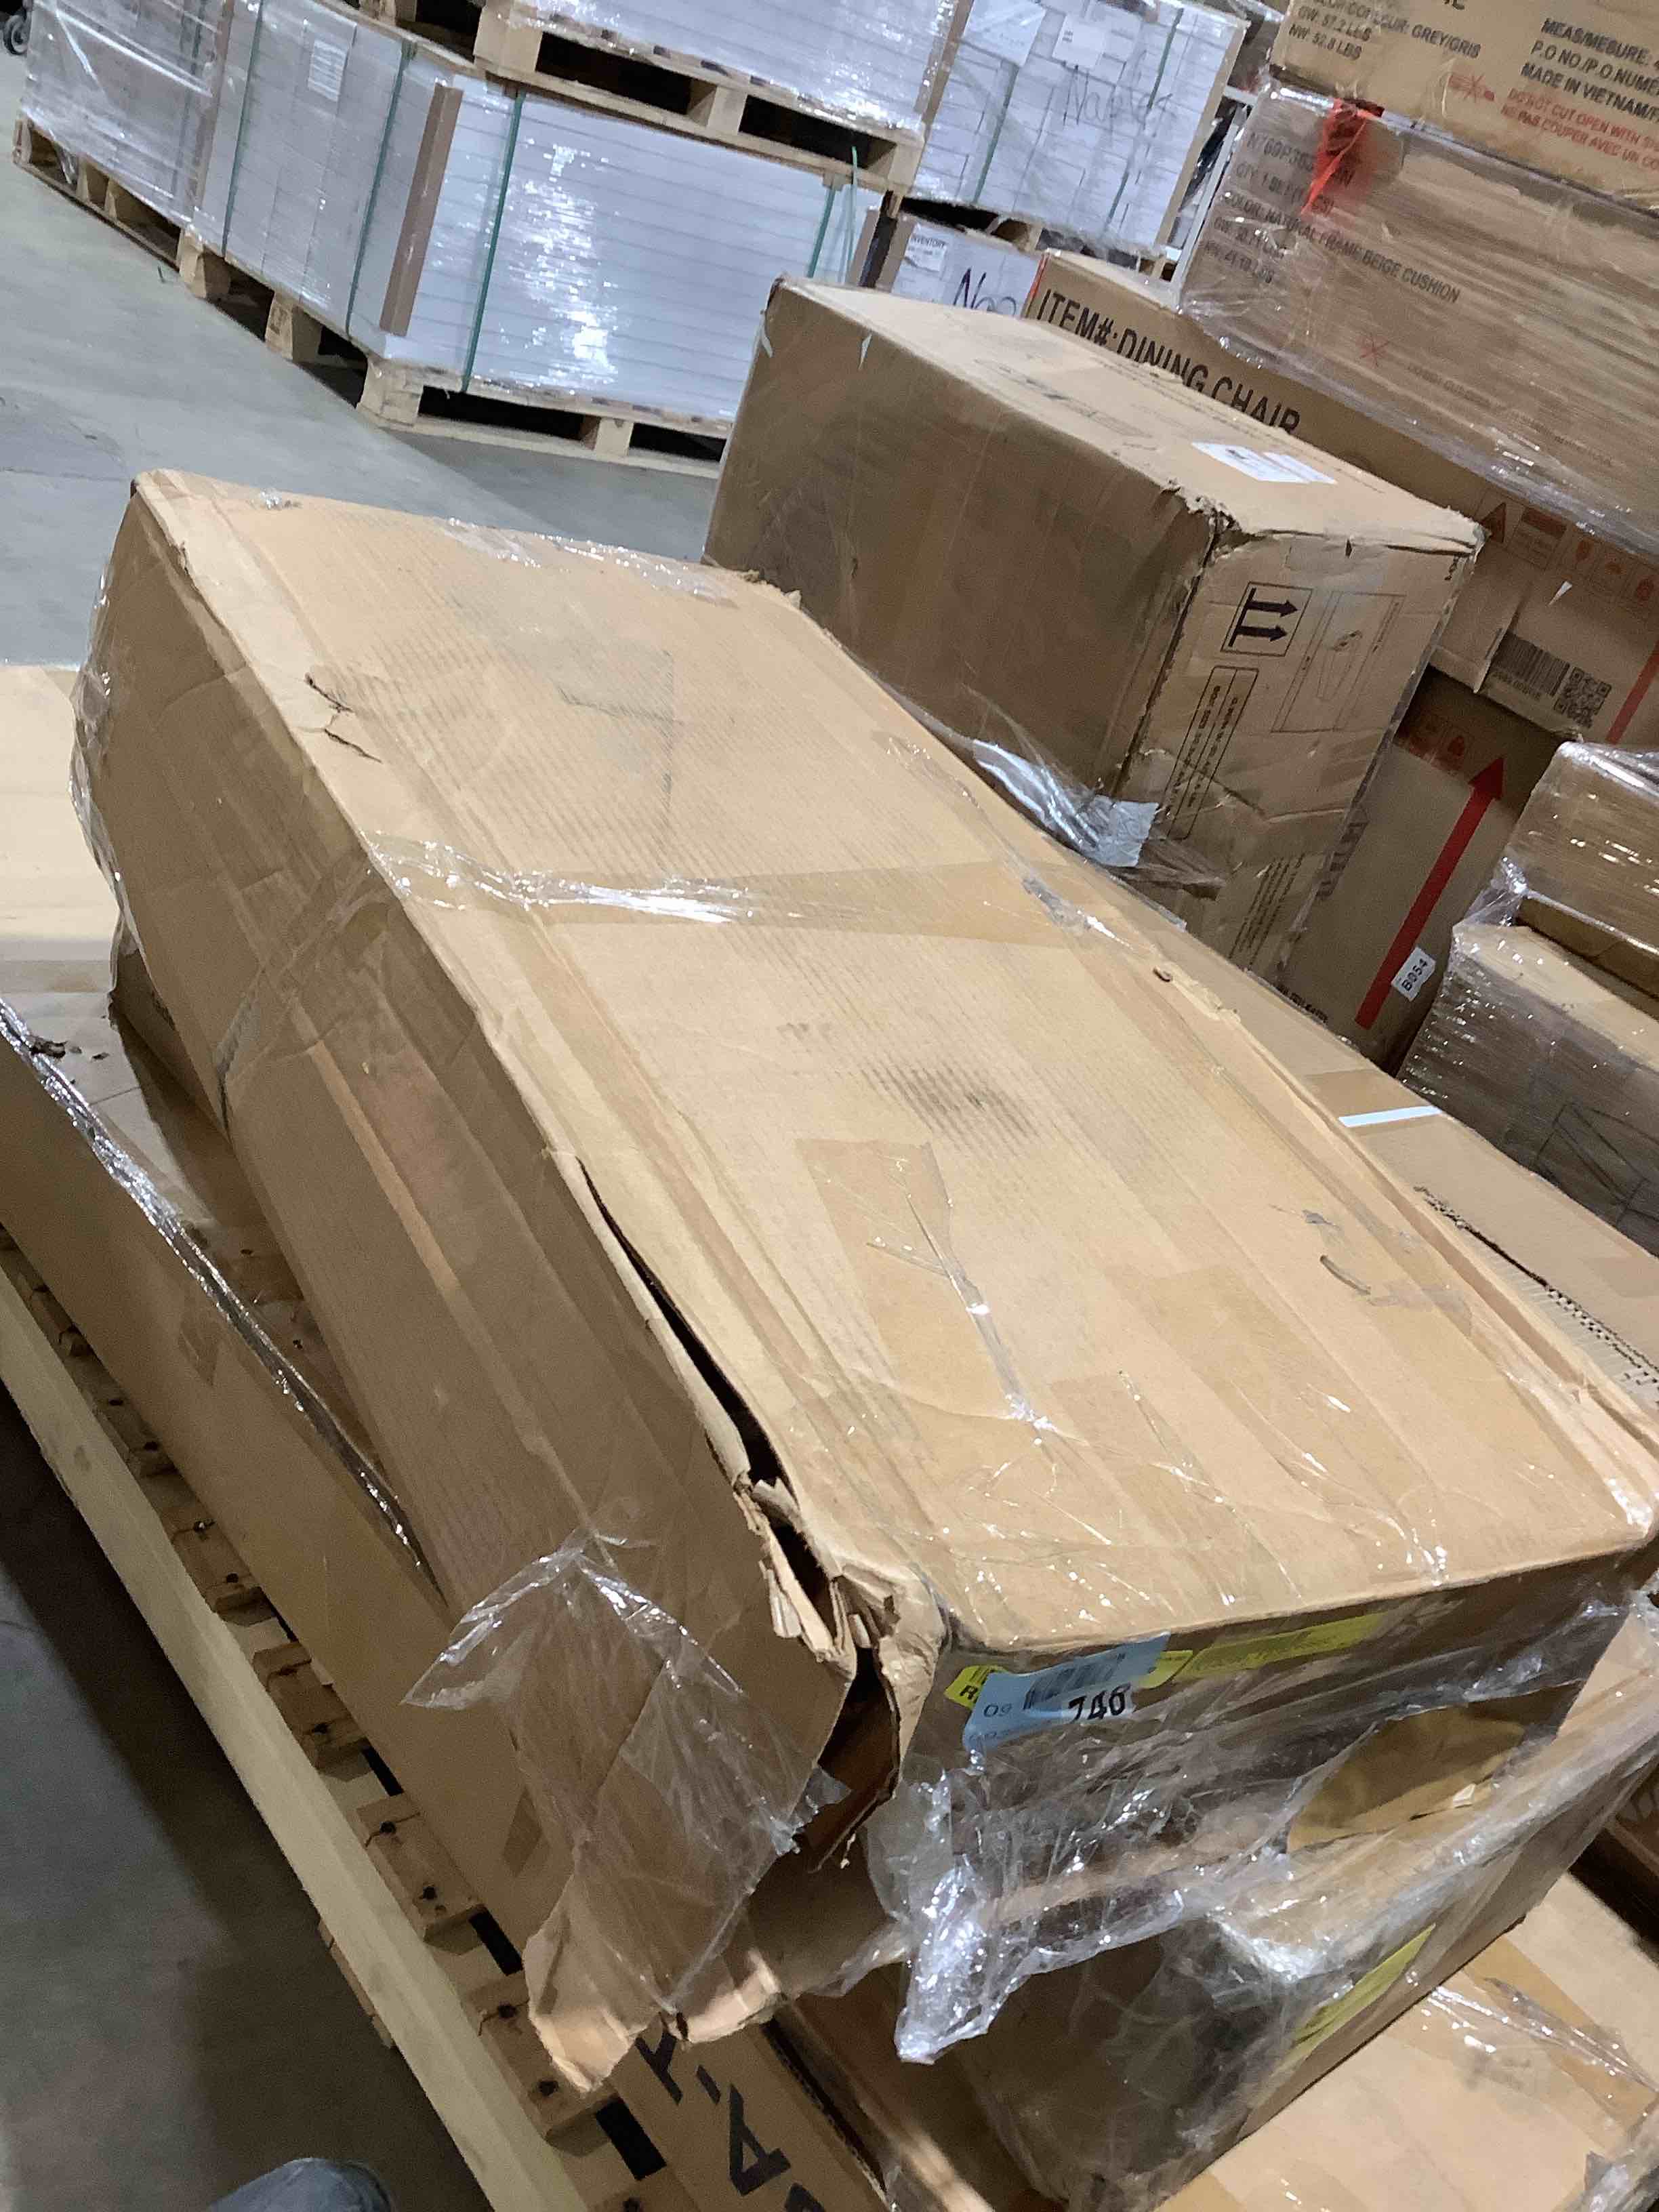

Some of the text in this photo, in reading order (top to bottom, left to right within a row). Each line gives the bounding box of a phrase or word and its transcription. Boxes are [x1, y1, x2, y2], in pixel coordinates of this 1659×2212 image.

[1519, 61, 1659, 124] MADE IN VIETNAM/F
[1551, 103, 1576, 121] CUT
[1576, 112, 1611, 134] OPEN
[1588, 136, 1622, 157] AVEC
[1401, 267, 1461, 304] CUSHION
[1115, 328, 1210, 392] DINING
[1210, 375, 1301, 435] CHAIR
